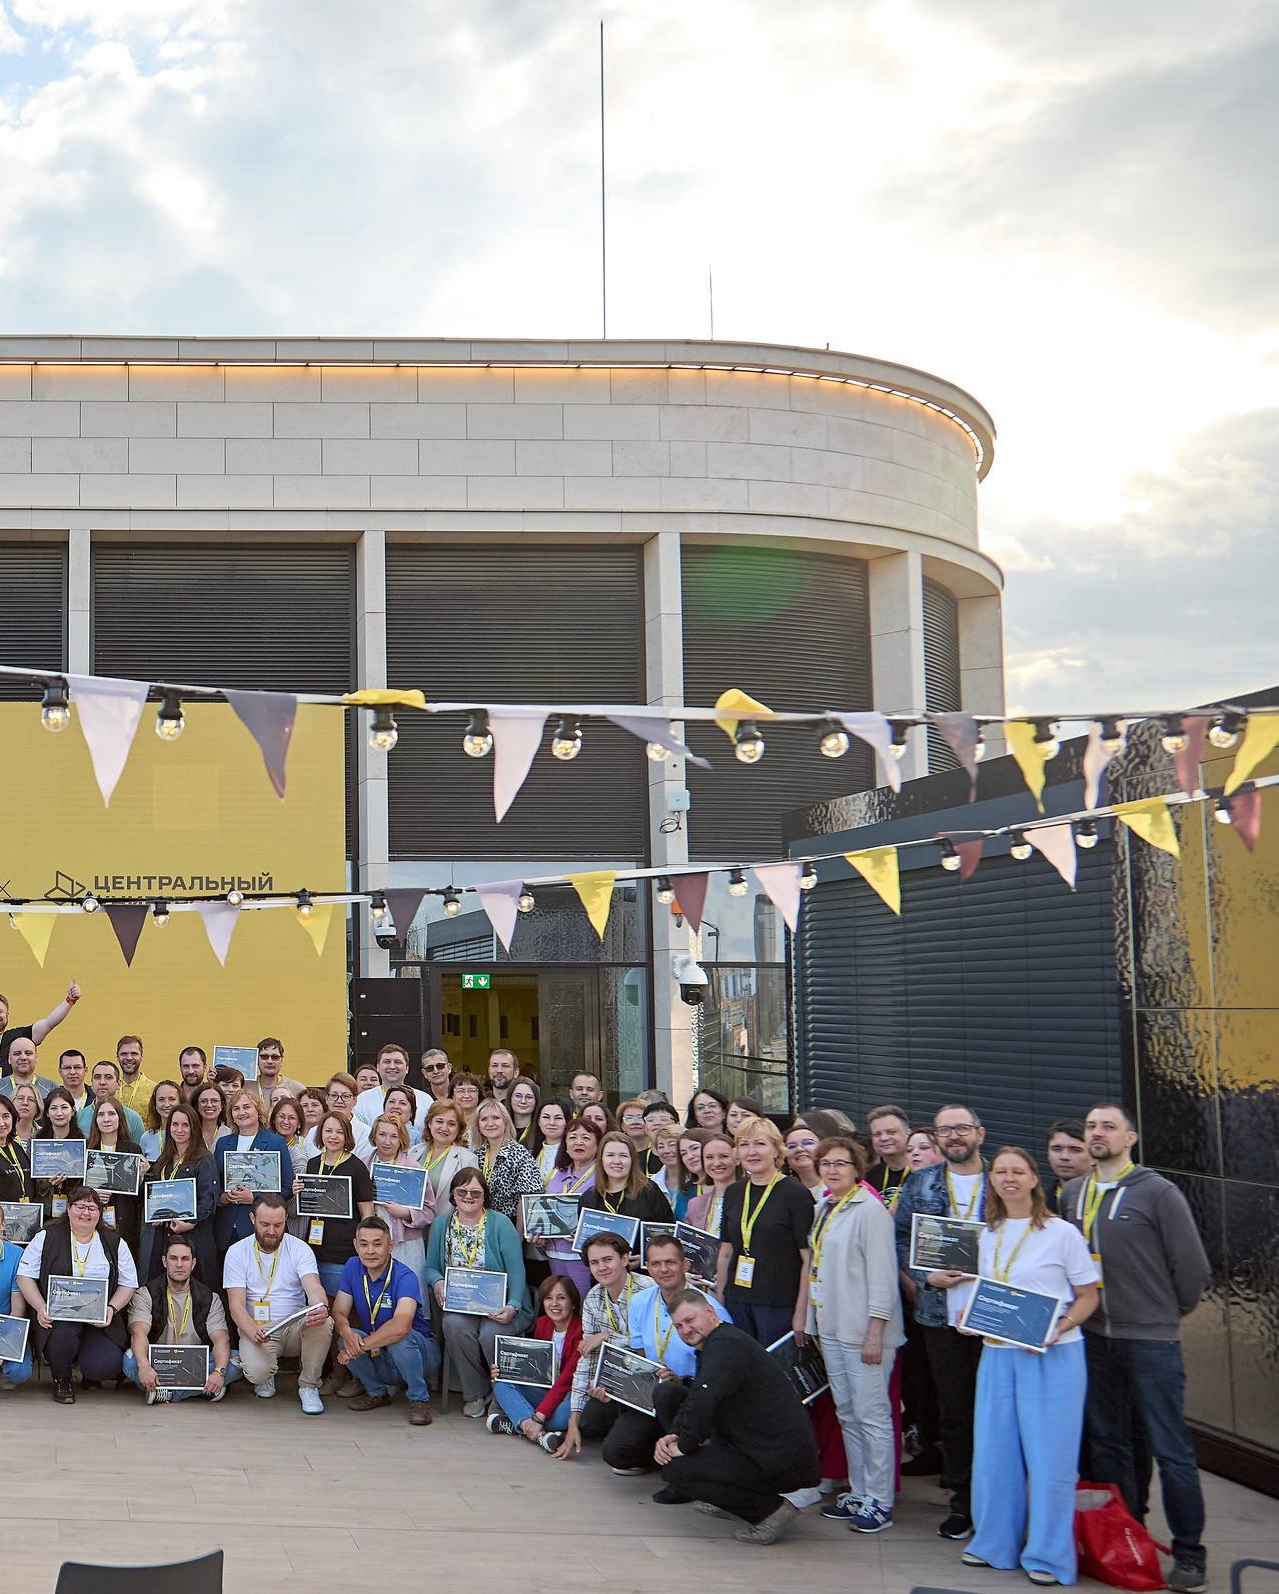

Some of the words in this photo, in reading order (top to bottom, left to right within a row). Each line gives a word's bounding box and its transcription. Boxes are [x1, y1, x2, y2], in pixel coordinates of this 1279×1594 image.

[94, 872, 273, 892] ЦЕНТРАЛЬНЫЙ
[450, 1281, 479, 1289] Сертификат
[500, 1350, 528, 1358] Сертификат
